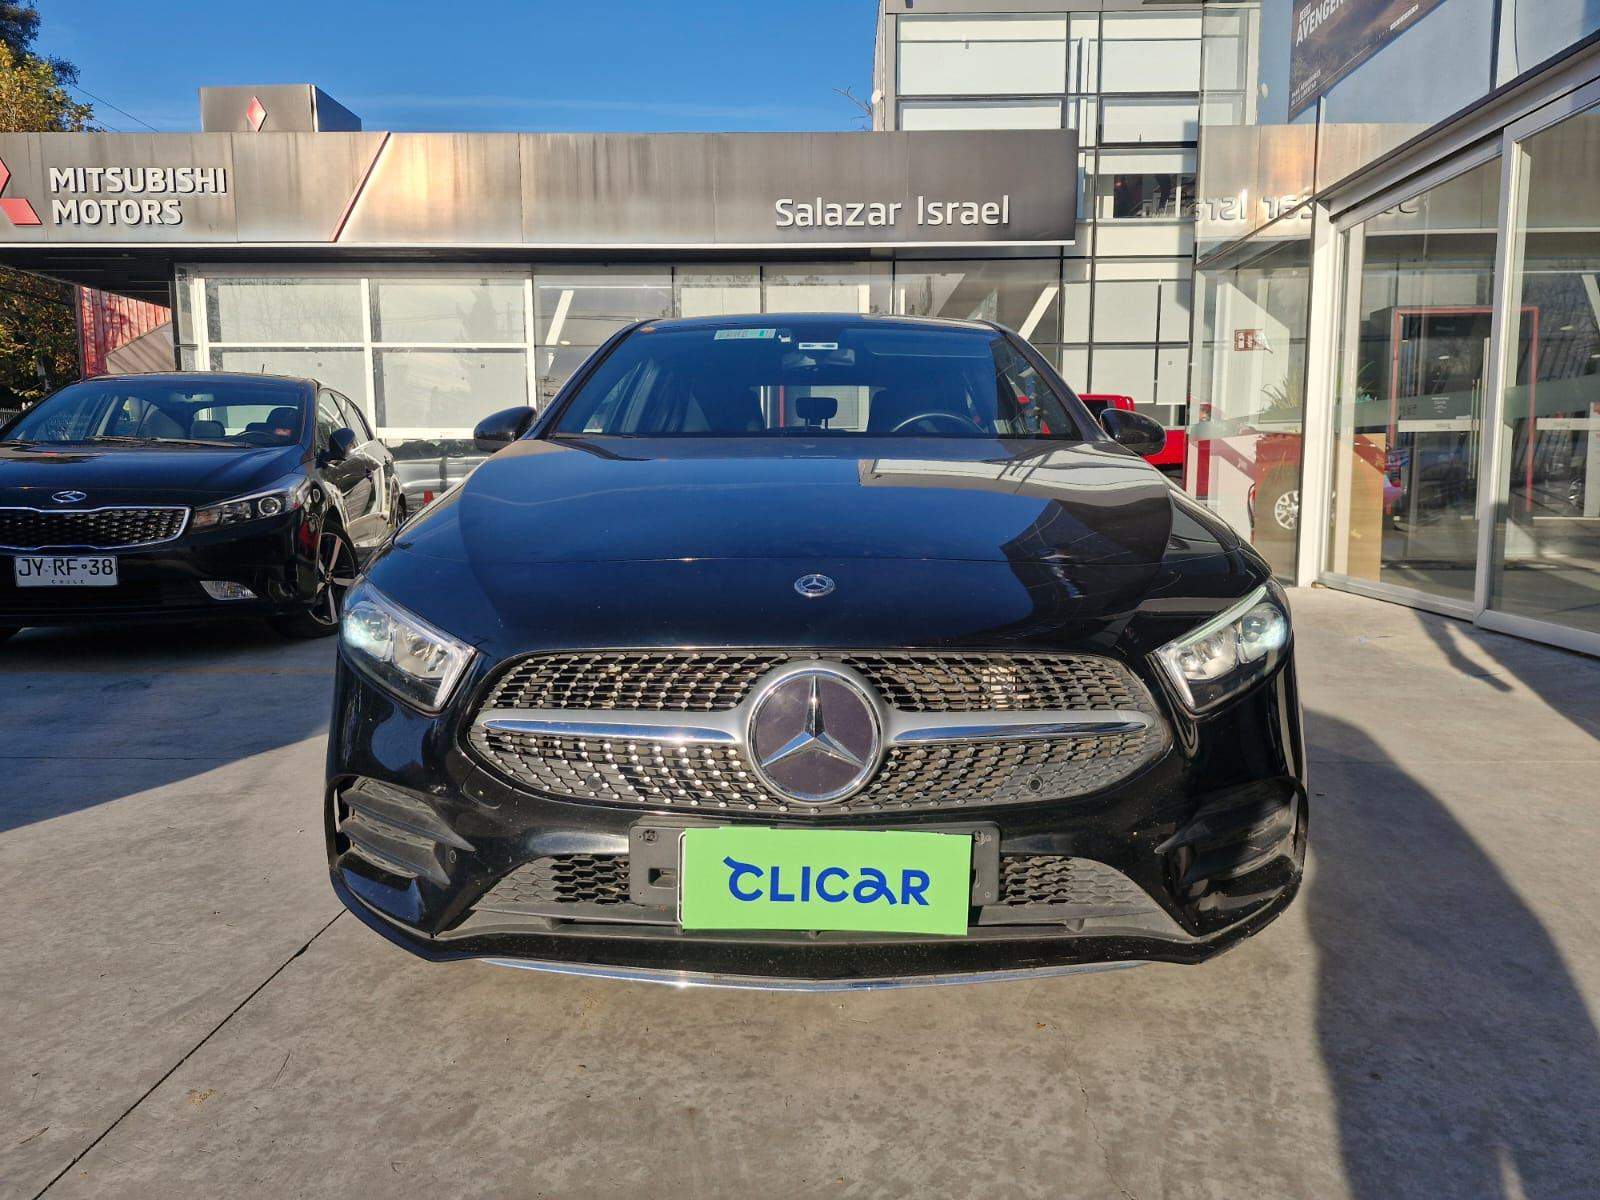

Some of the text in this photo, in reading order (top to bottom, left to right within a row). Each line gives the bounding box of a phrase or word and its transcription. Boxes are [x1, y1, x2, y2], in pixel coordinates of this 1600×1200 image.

[49, 167, 226, 193] MITSUBISHI
[52, 199, 182, 225] MOTORS
[775, 194, 1009, 227] Salazar Israel
